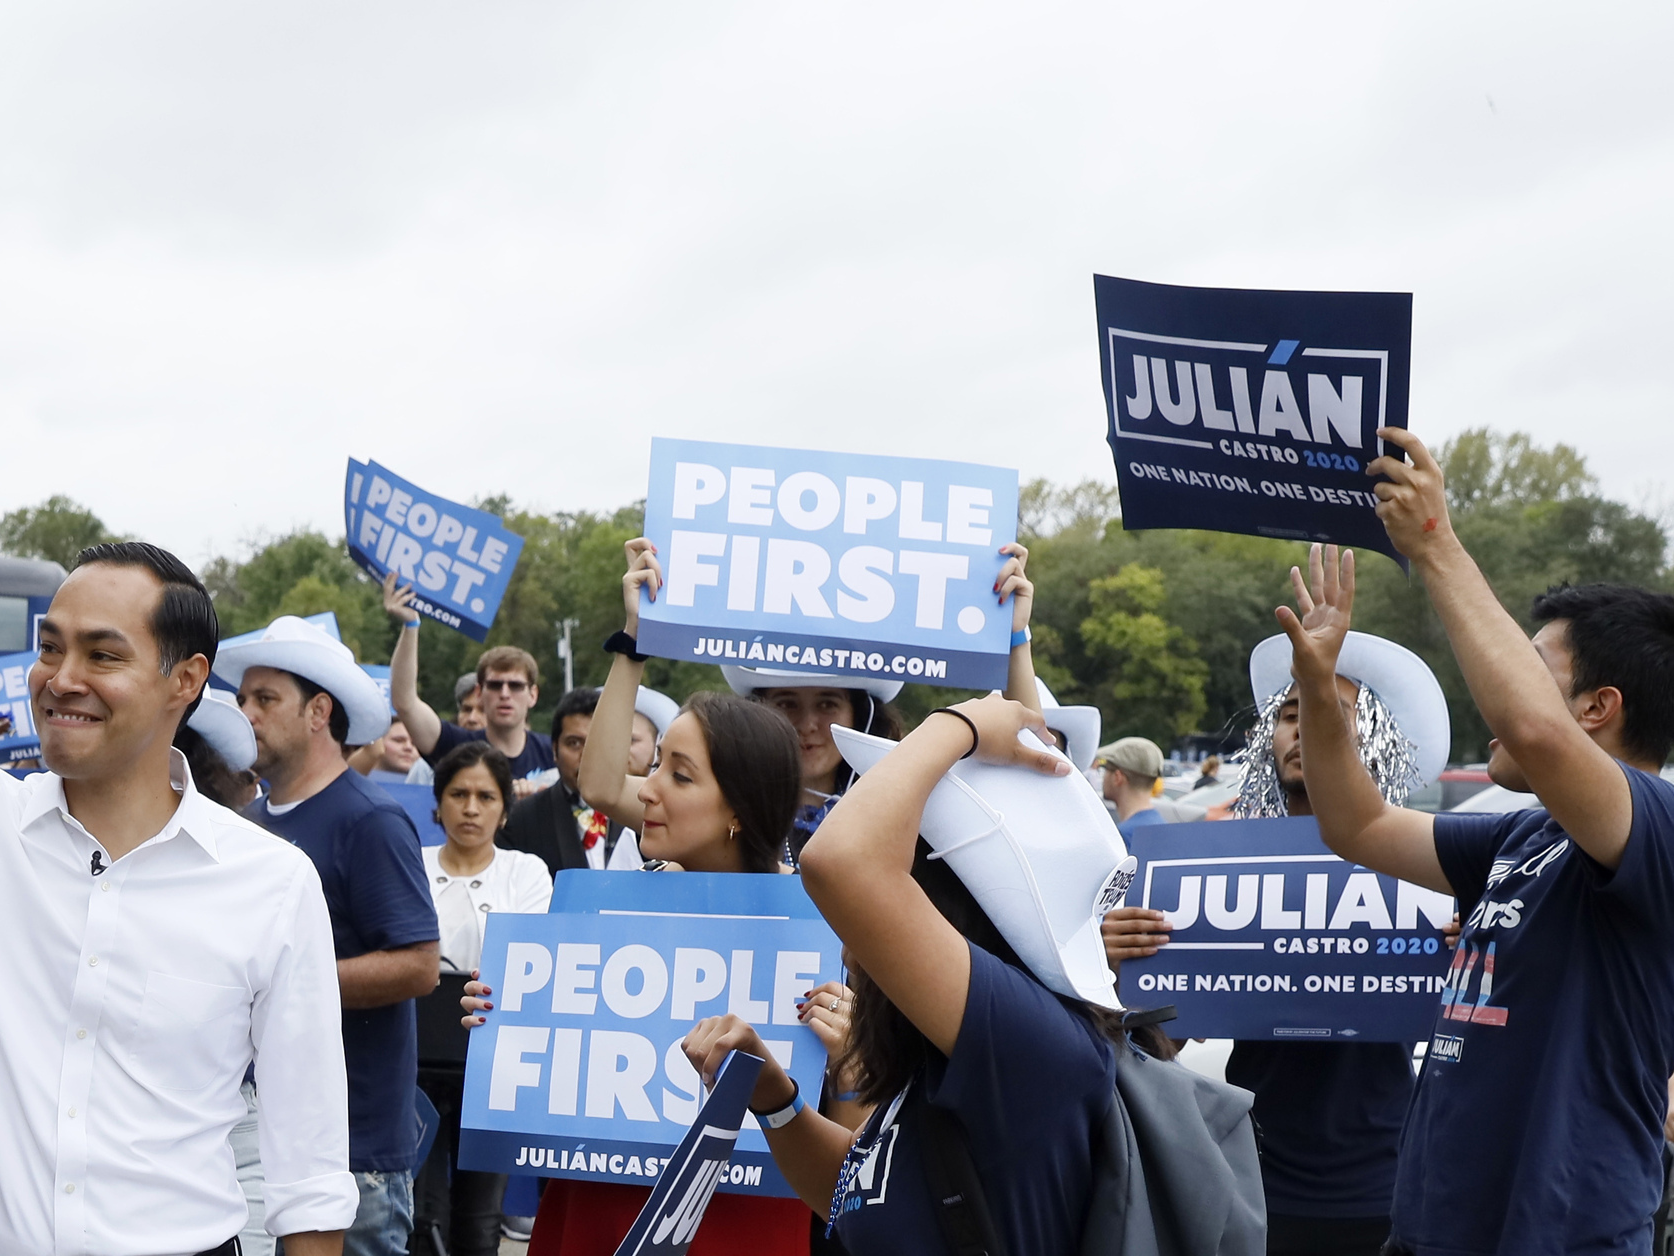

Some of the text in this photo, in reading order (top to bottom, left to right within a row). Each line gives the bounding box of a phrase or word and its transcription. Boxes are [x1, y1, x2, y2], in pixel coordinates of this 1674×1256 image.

[1126, 340, 1363, 449] JULIÁN
[1129, 462, 1377, 509] ONE NATION. ONE DESTI
[1219, 439, 1359, 472] CASTRO 2020
[365, 474, 509, 574] PEOPLE
[672, 461, 994, 546] PEOPLE
[359, 509, 486, 613] FIRST.
[665, 531, 985, 634] FIRST.
[693, 636, 948, 679] JULIÁNCASTRO.COM
[1162, 863, 1455, 931] JULIÁN
[1138, 974, 1189, 992] ONE
[1194, 974, 1299, 993] NATION.
[1304, 975, 1358, 993] ONE
[1273, 937, 1439, 955] CASTRO 2020
[500, 942, 821, 1027] PEOPLE
